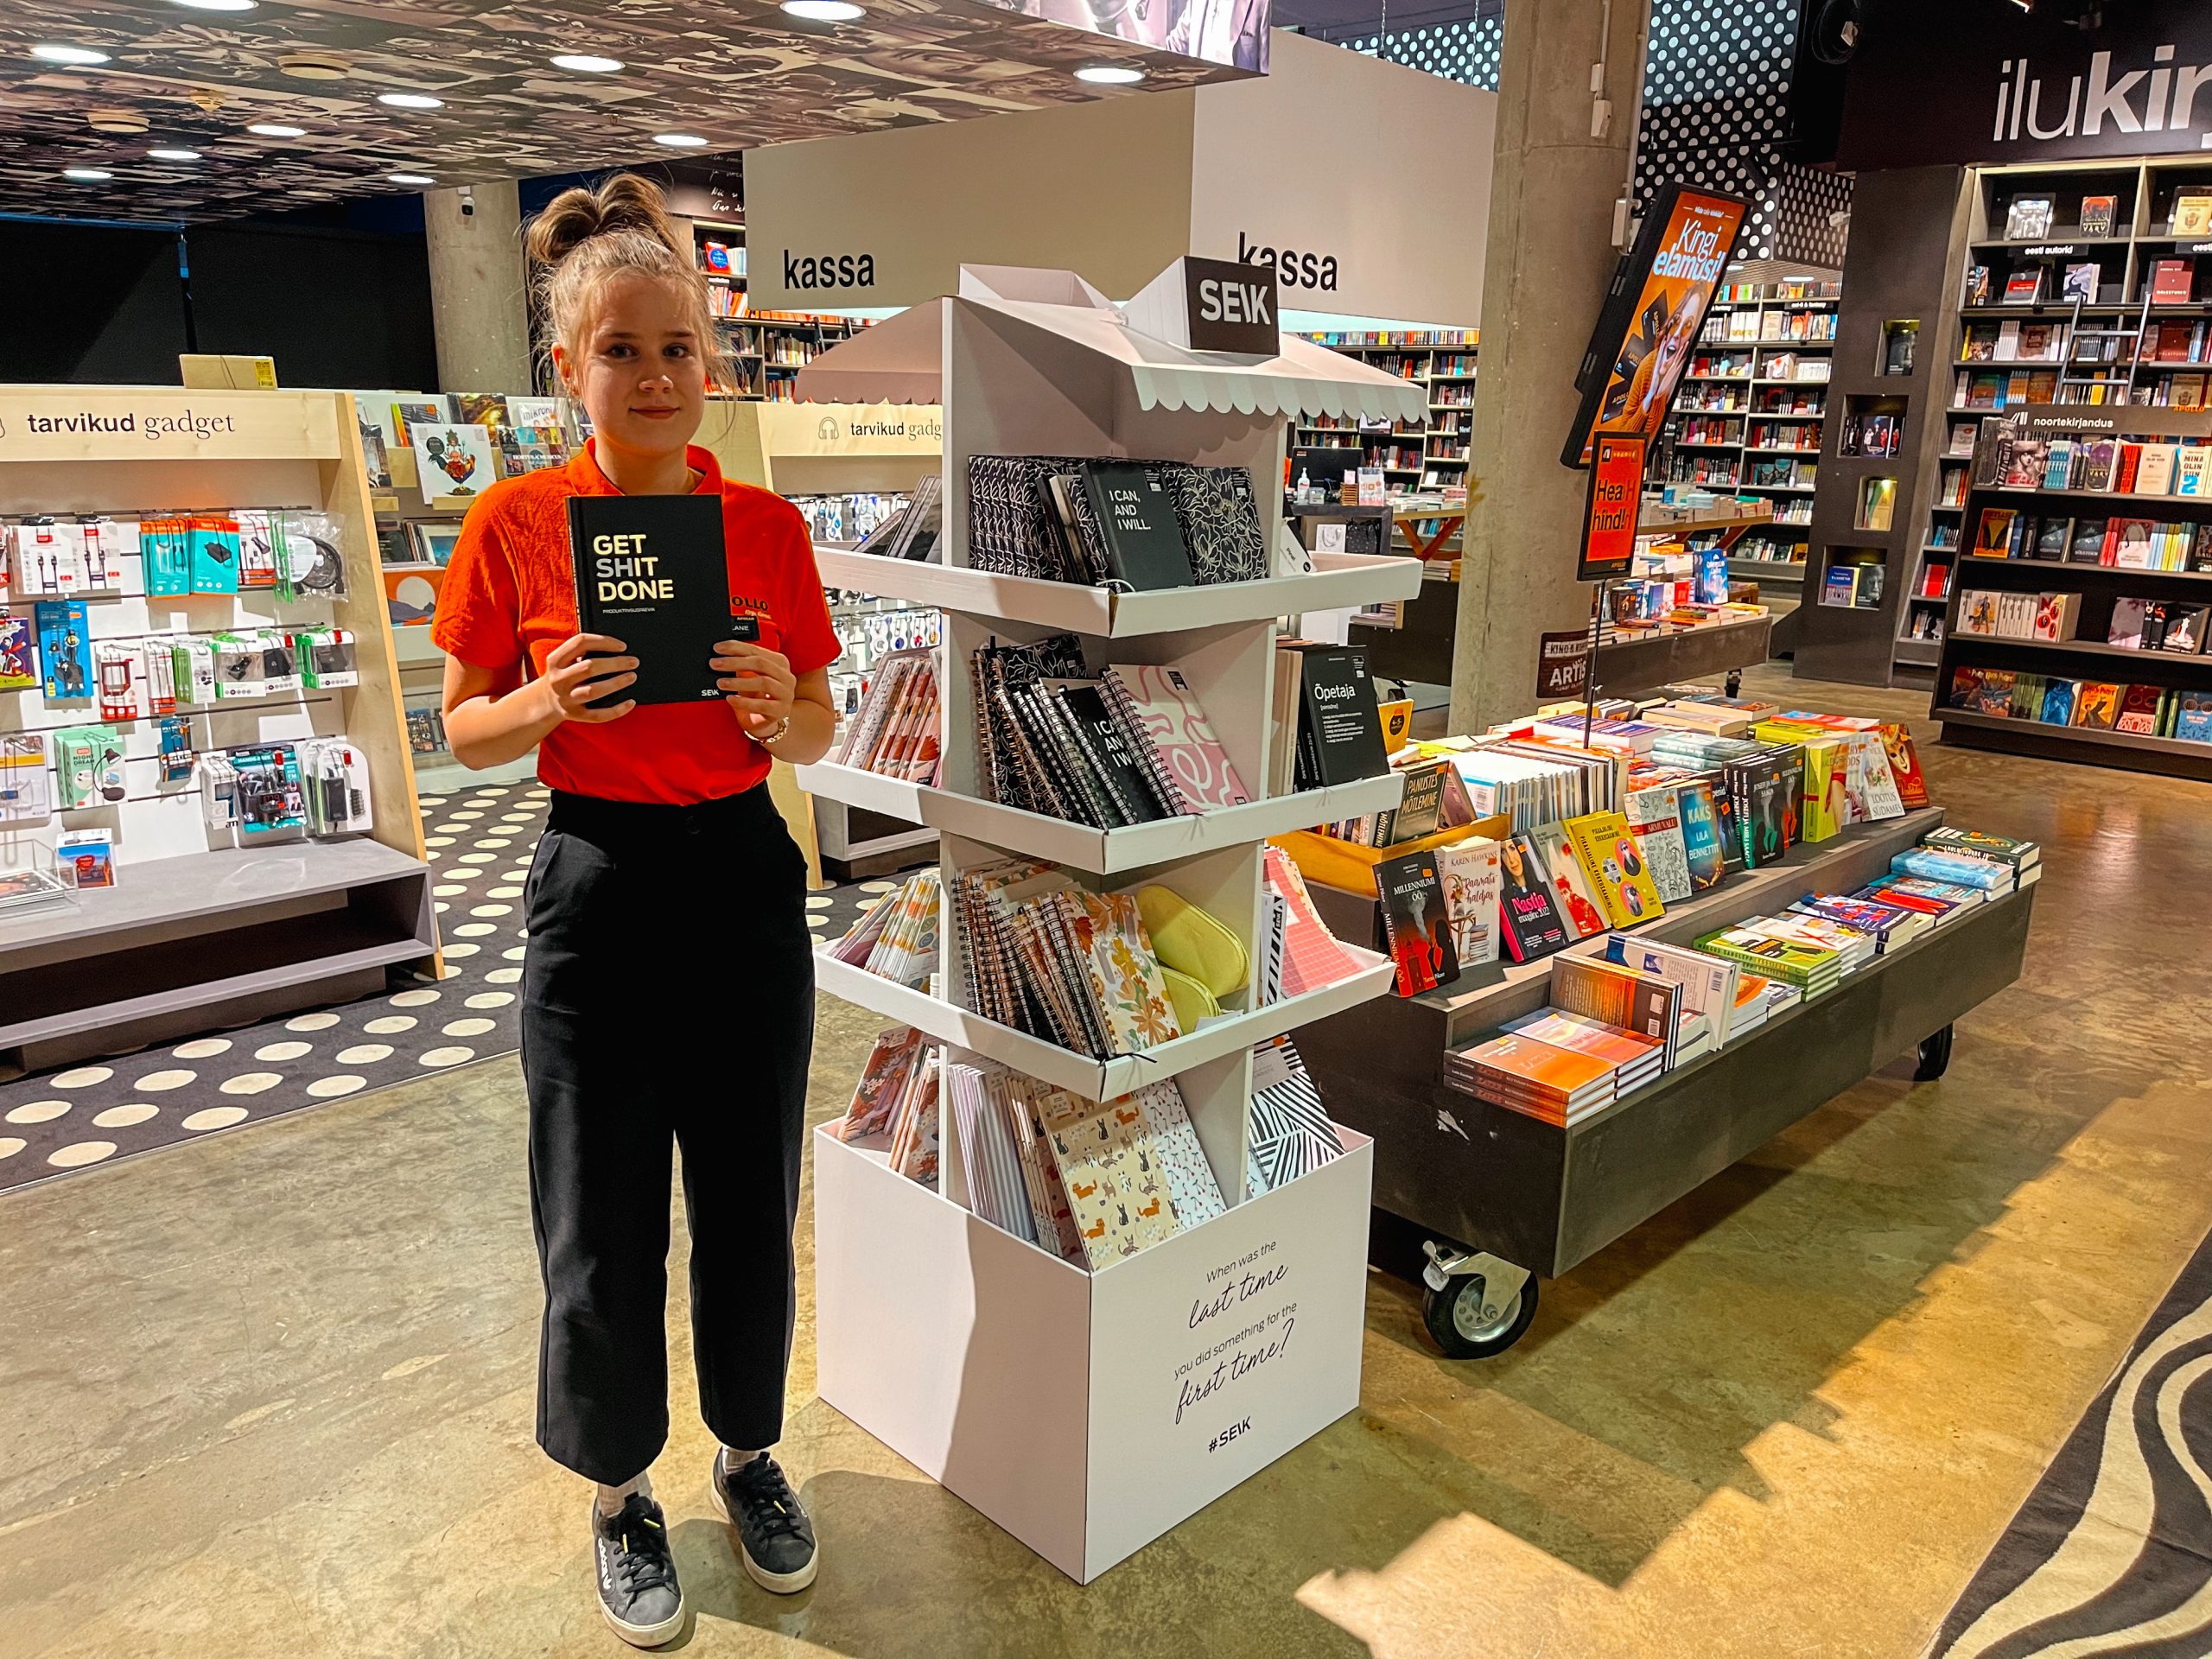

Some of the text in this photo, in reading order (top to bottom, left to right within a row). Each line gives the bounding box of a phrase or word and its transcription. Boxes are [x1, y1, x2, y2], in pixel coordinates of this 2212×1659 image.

[1993, 45, 2212, 149] ilukir
[1675, 218, 1722, 263] Kingi
[784, 249, 874, 289] kassa
[1239, 232, 1338, 292] kassa
[1653, 243, 1726, 283] elamusi!
[28, 410, 236, 440] tarvikud gadget
[850, 419, 942, 441] tarvikud gadg
[2033, 417, 2113, 429] noortekirjandus
[1596, 479, 1624, 501] Hea
[2181, 475, 2198, 493] 2
[1109, 490, 1141, 503] I CAN,
[1115, 505, 1137, 516] AND
[1592, 508, 1624, 531] hind!
[1117, 518, 1151, 531] I WILL.
[594, 534, 646, 555] GET
[596, 556, 658, 578] SHIT
[598, 580, 675, 601] DONE
[731, 595, 769, 612] OLLO
[1550, 644, 1568, 654] KINO
[1314, 683, 1356, 702] Õpetaja
[1104, 735, 1125, 752] AN
[1402, 791, 1438, 814] MÕTLEMINE
[1687, 805, 1712, 824] KAKS
[1452, 856, 1470, 867] KAREN
[1394, 877, 1435, 895] MILLENNIUMI
[1206, 1240, 1276, 1284] When was the
[1189, 1264, 1288, 1329] last time
[1174, 1301, 1297, 1381] you did something for the
[1175, 1318, 1294, 1425] first time?
